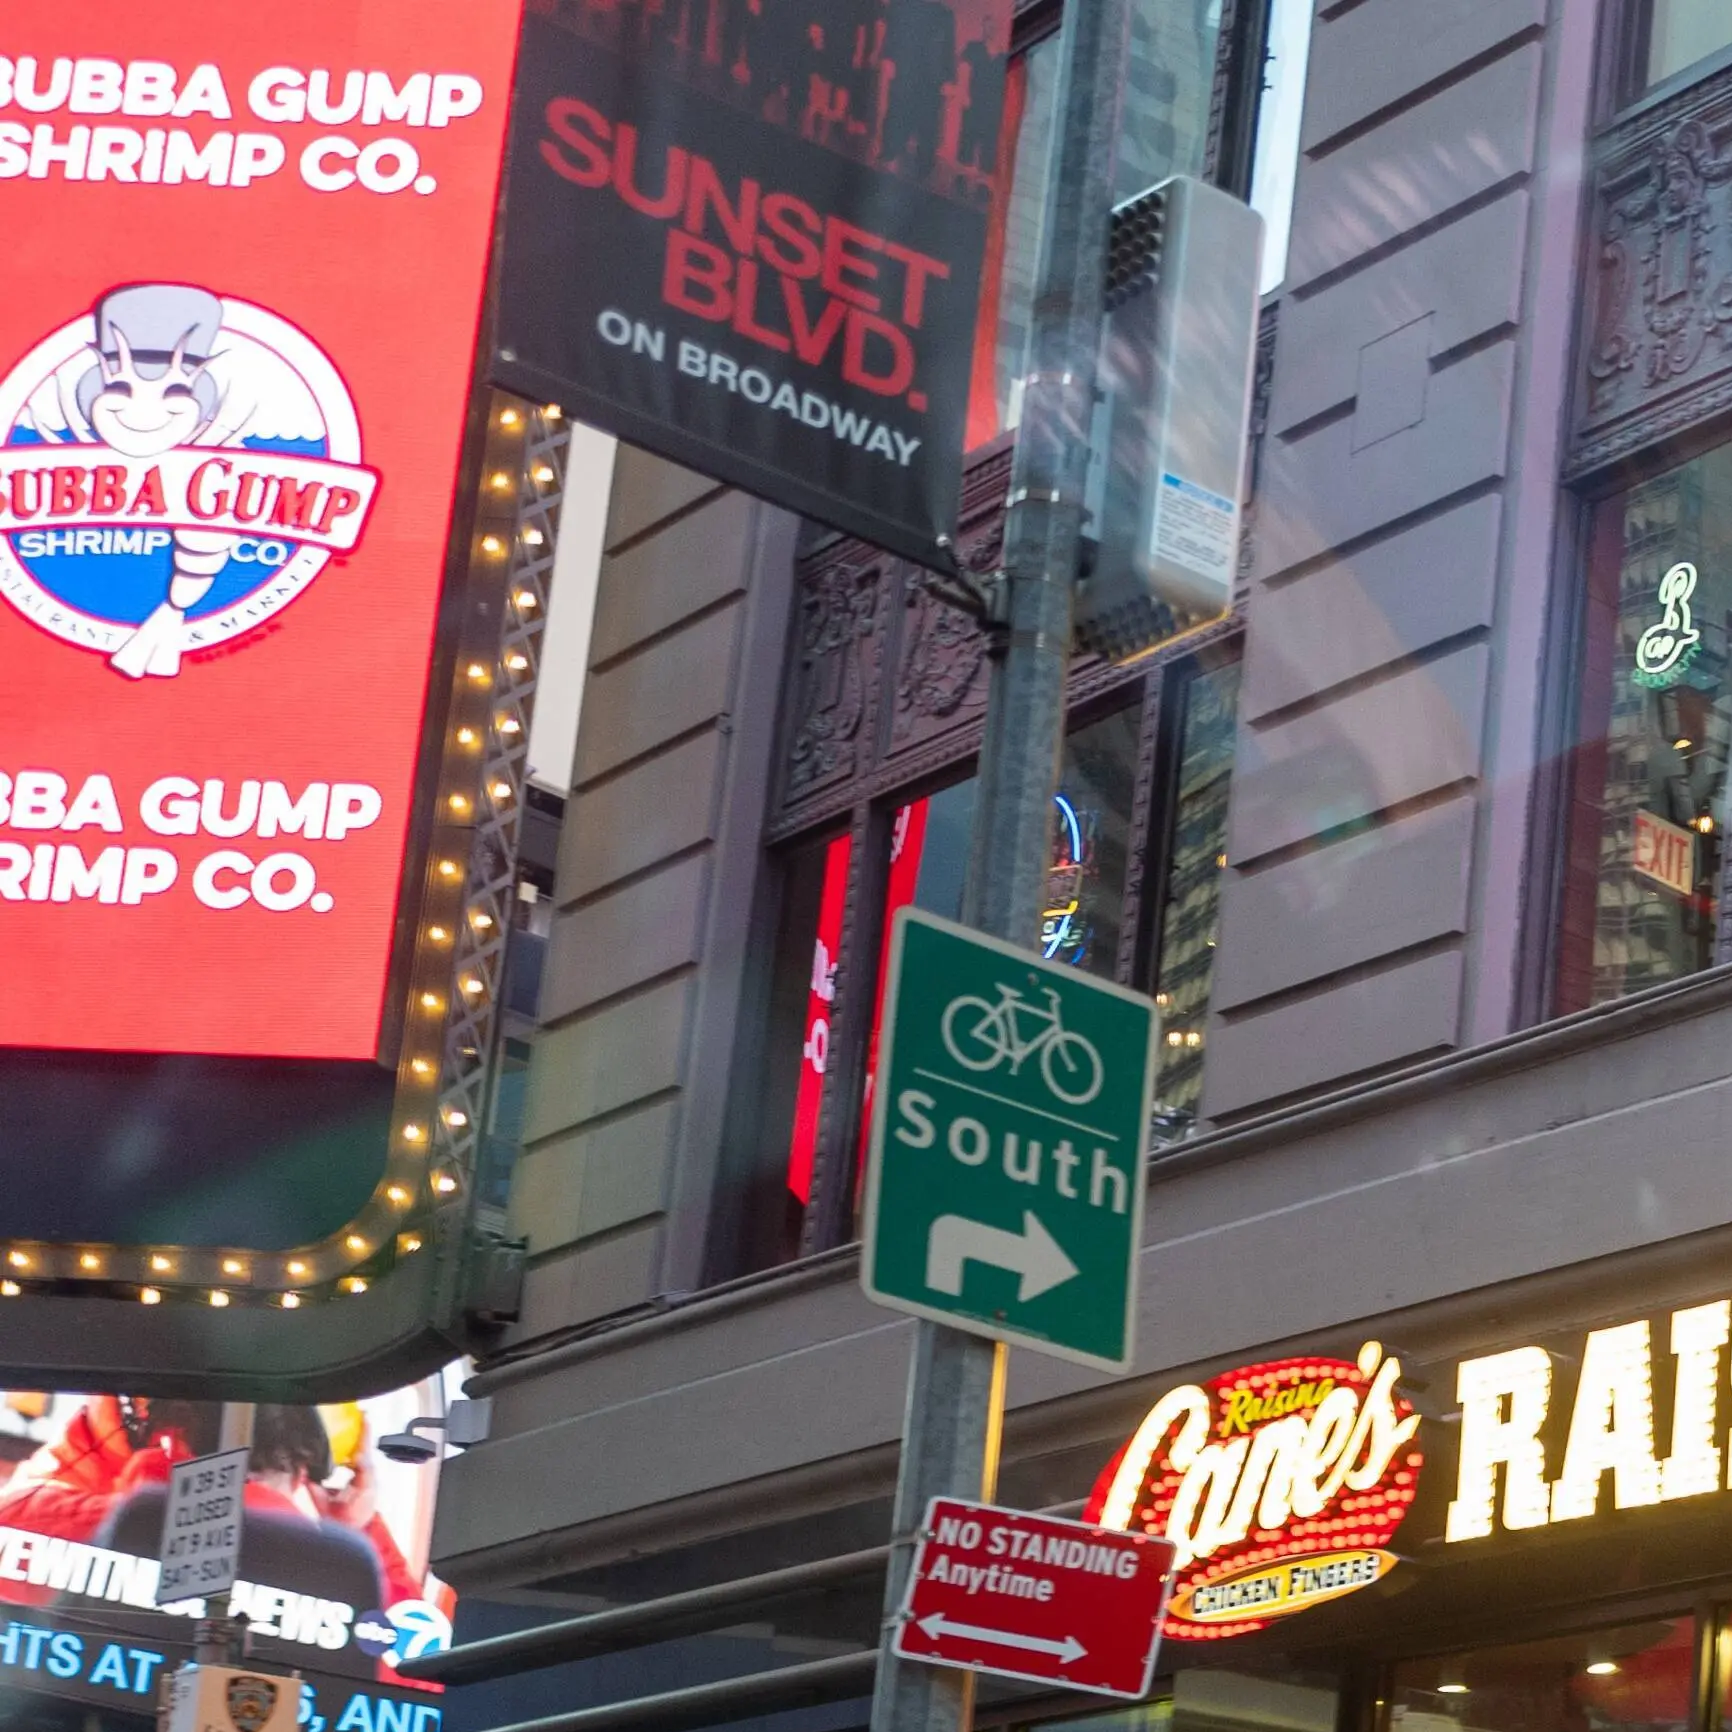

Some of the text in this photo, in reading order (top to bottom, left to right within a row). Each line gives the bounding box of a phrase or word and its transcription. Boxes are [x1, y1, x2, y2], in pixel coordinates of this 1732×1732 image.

[248, 69, 482, 128] GUMP
[0, 126, 437, 195] SHRIMP CO.
[539, 96, 950, 328] SUNSET
[662, 227, 928, 412] BLVD.
[597, 308, 921, 466] ON BROADWAY
[187, 458, 362, 533] GUMP
[18, 529, 173, 558] SHRIMP
[0, 770, 382, 840] BA GUMP
[193, 851, 334, 912] CO.
[1633, 817, 1692, 889] EXIT
[894, 1089, 1130, 1214] South
[1220, 1376, 1336, 1437] Raising
[1108, 1340, 1422, 1571] Cane's
[174, 1496, 232, 1527] CLOSED
[929, 1555, 1053, 1602] Anytime
[936, 1516, 1138, 1578] NO STANDING
[1193, 1553, 1380, 1614] CHICKEN FINGERS
[90, 1644, 163, 1693] AT
